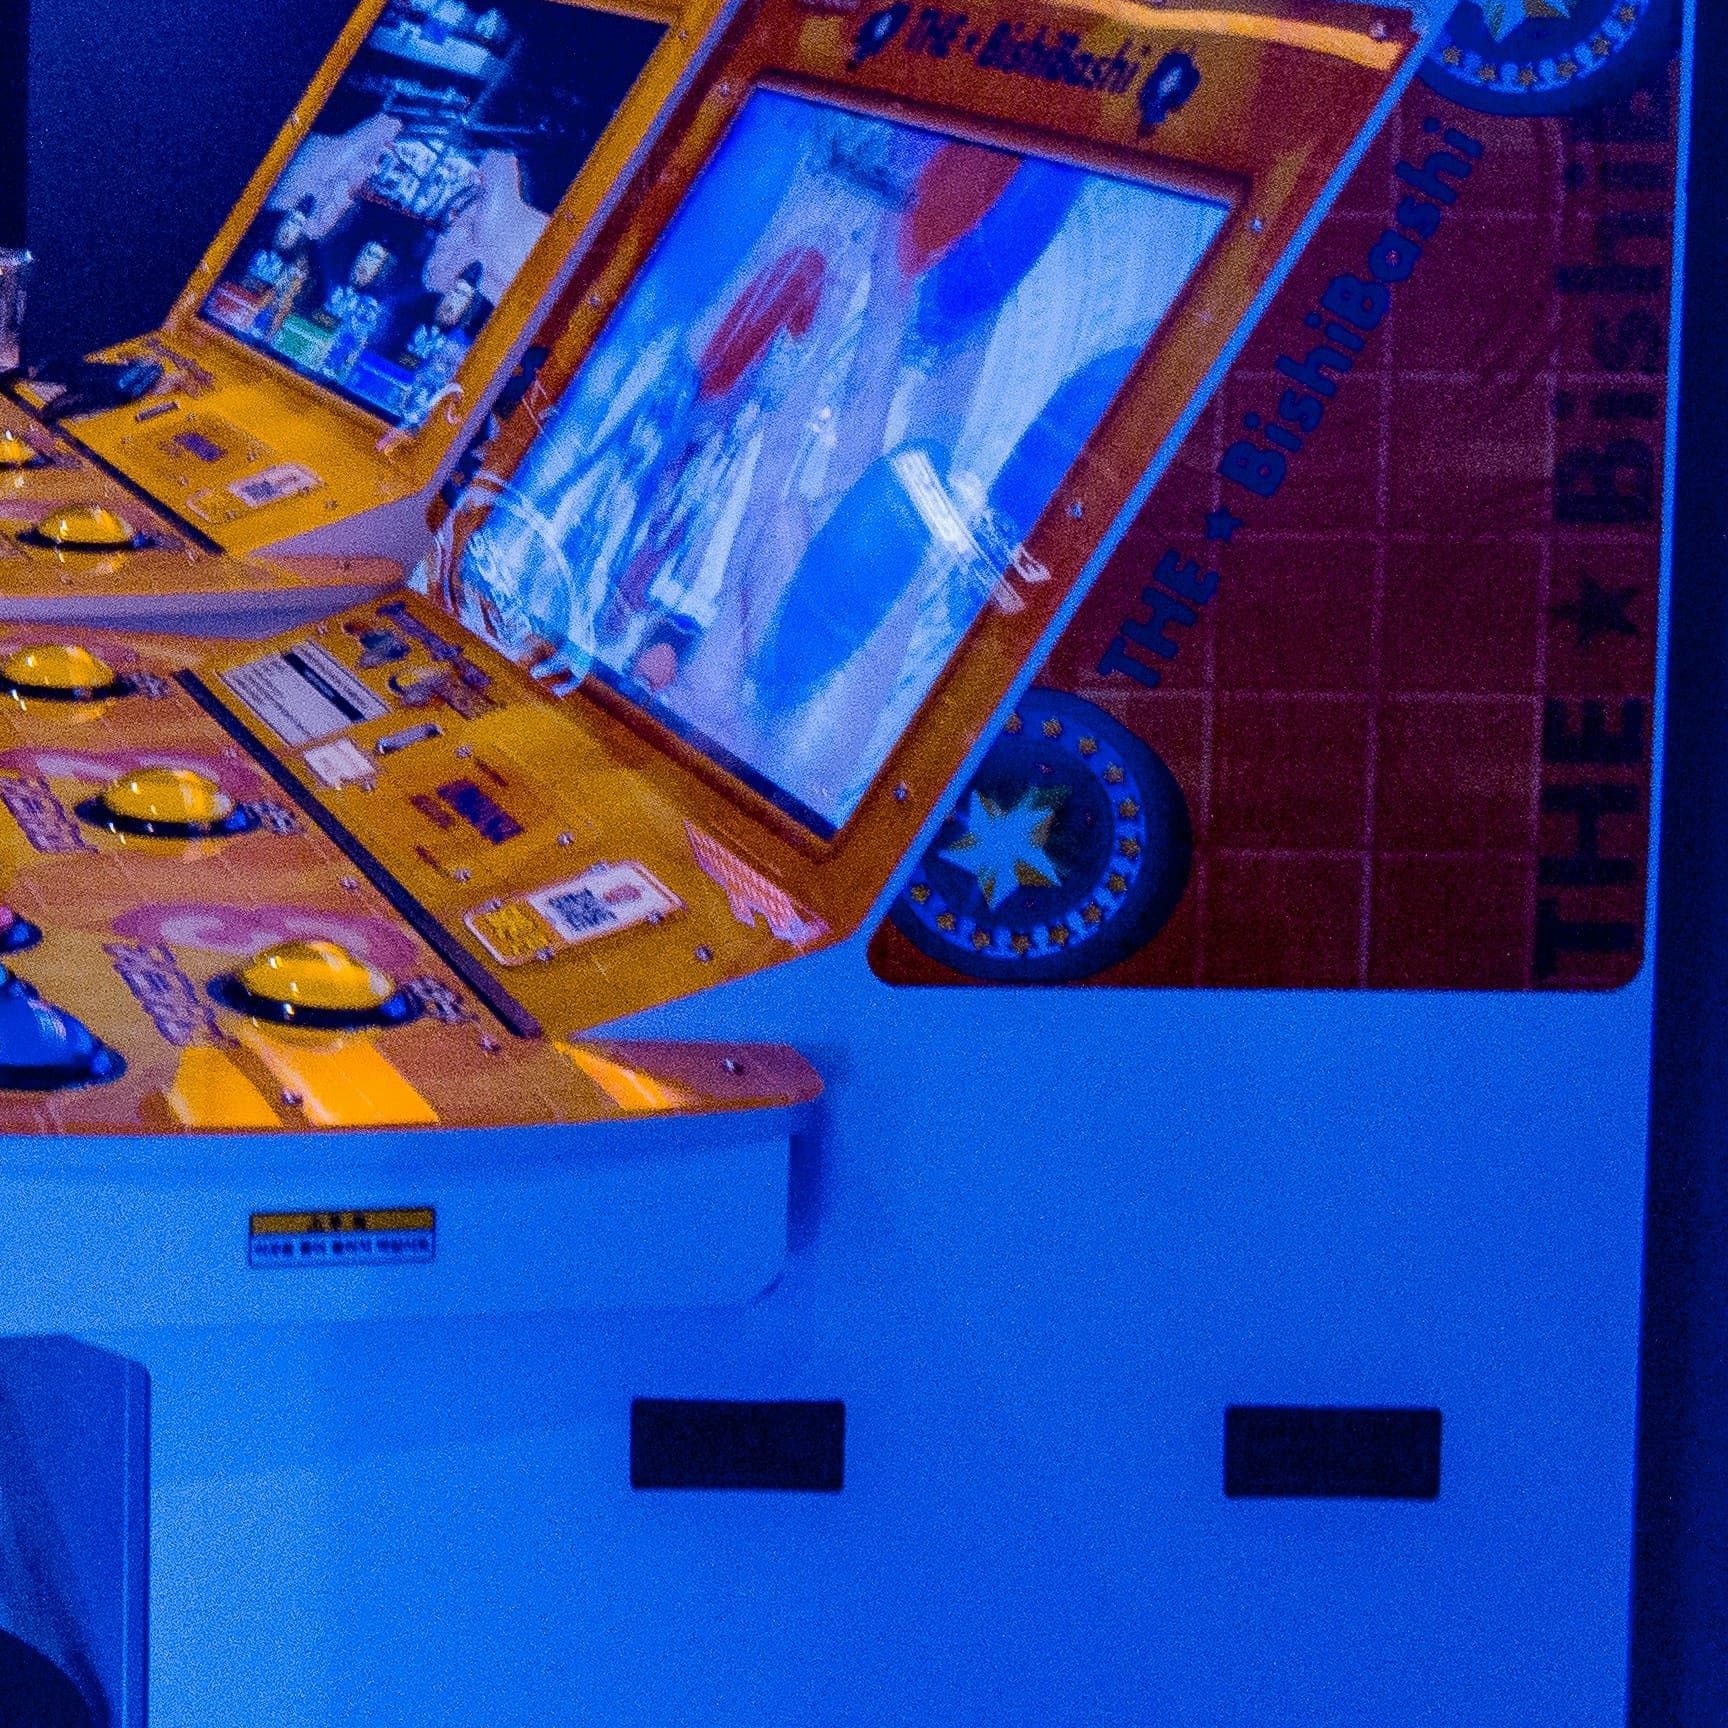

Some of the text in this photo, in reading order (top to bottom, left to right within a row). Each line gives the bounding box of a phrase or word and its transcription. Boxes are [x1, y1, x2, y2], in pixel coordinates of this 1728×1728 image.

[1097, 115, 1485, 688] THE BishiBashi
[1530, 698, 1648, 980] THE
